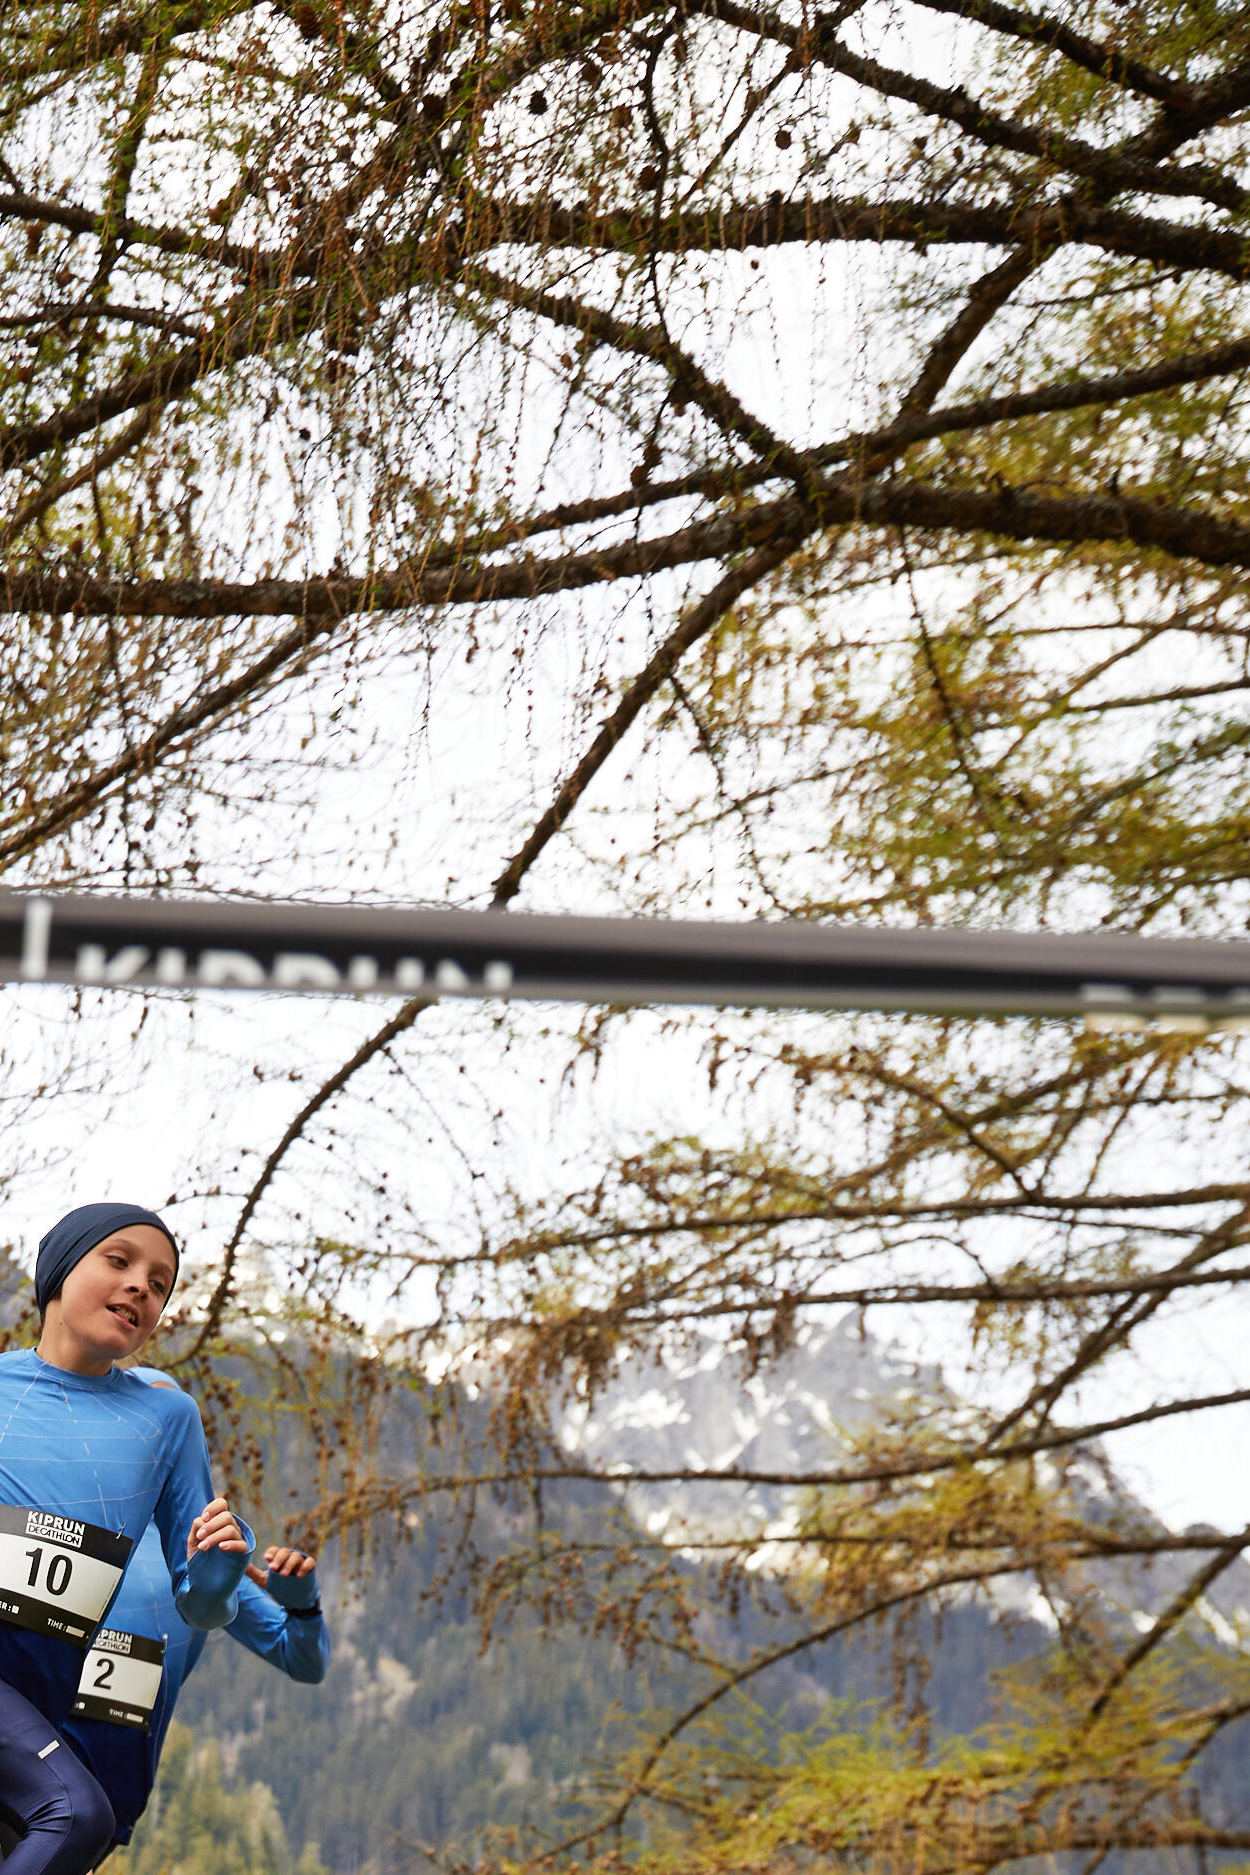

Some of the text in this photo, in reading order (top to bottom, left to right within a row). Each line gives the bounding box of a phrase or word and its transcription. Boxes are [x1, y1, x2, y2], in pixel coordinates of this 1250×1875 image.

[27, 1510, 86, 1536] KIPRUN
[28, 1524, 81, 1546] DECATHLON
[25, 1547, 74, 1596] 10
[94, 1639, 129, 1653] CATHLON
[97, 1628, 133, 1644] PRUN
[93, 1658, 115, 1690] 2
